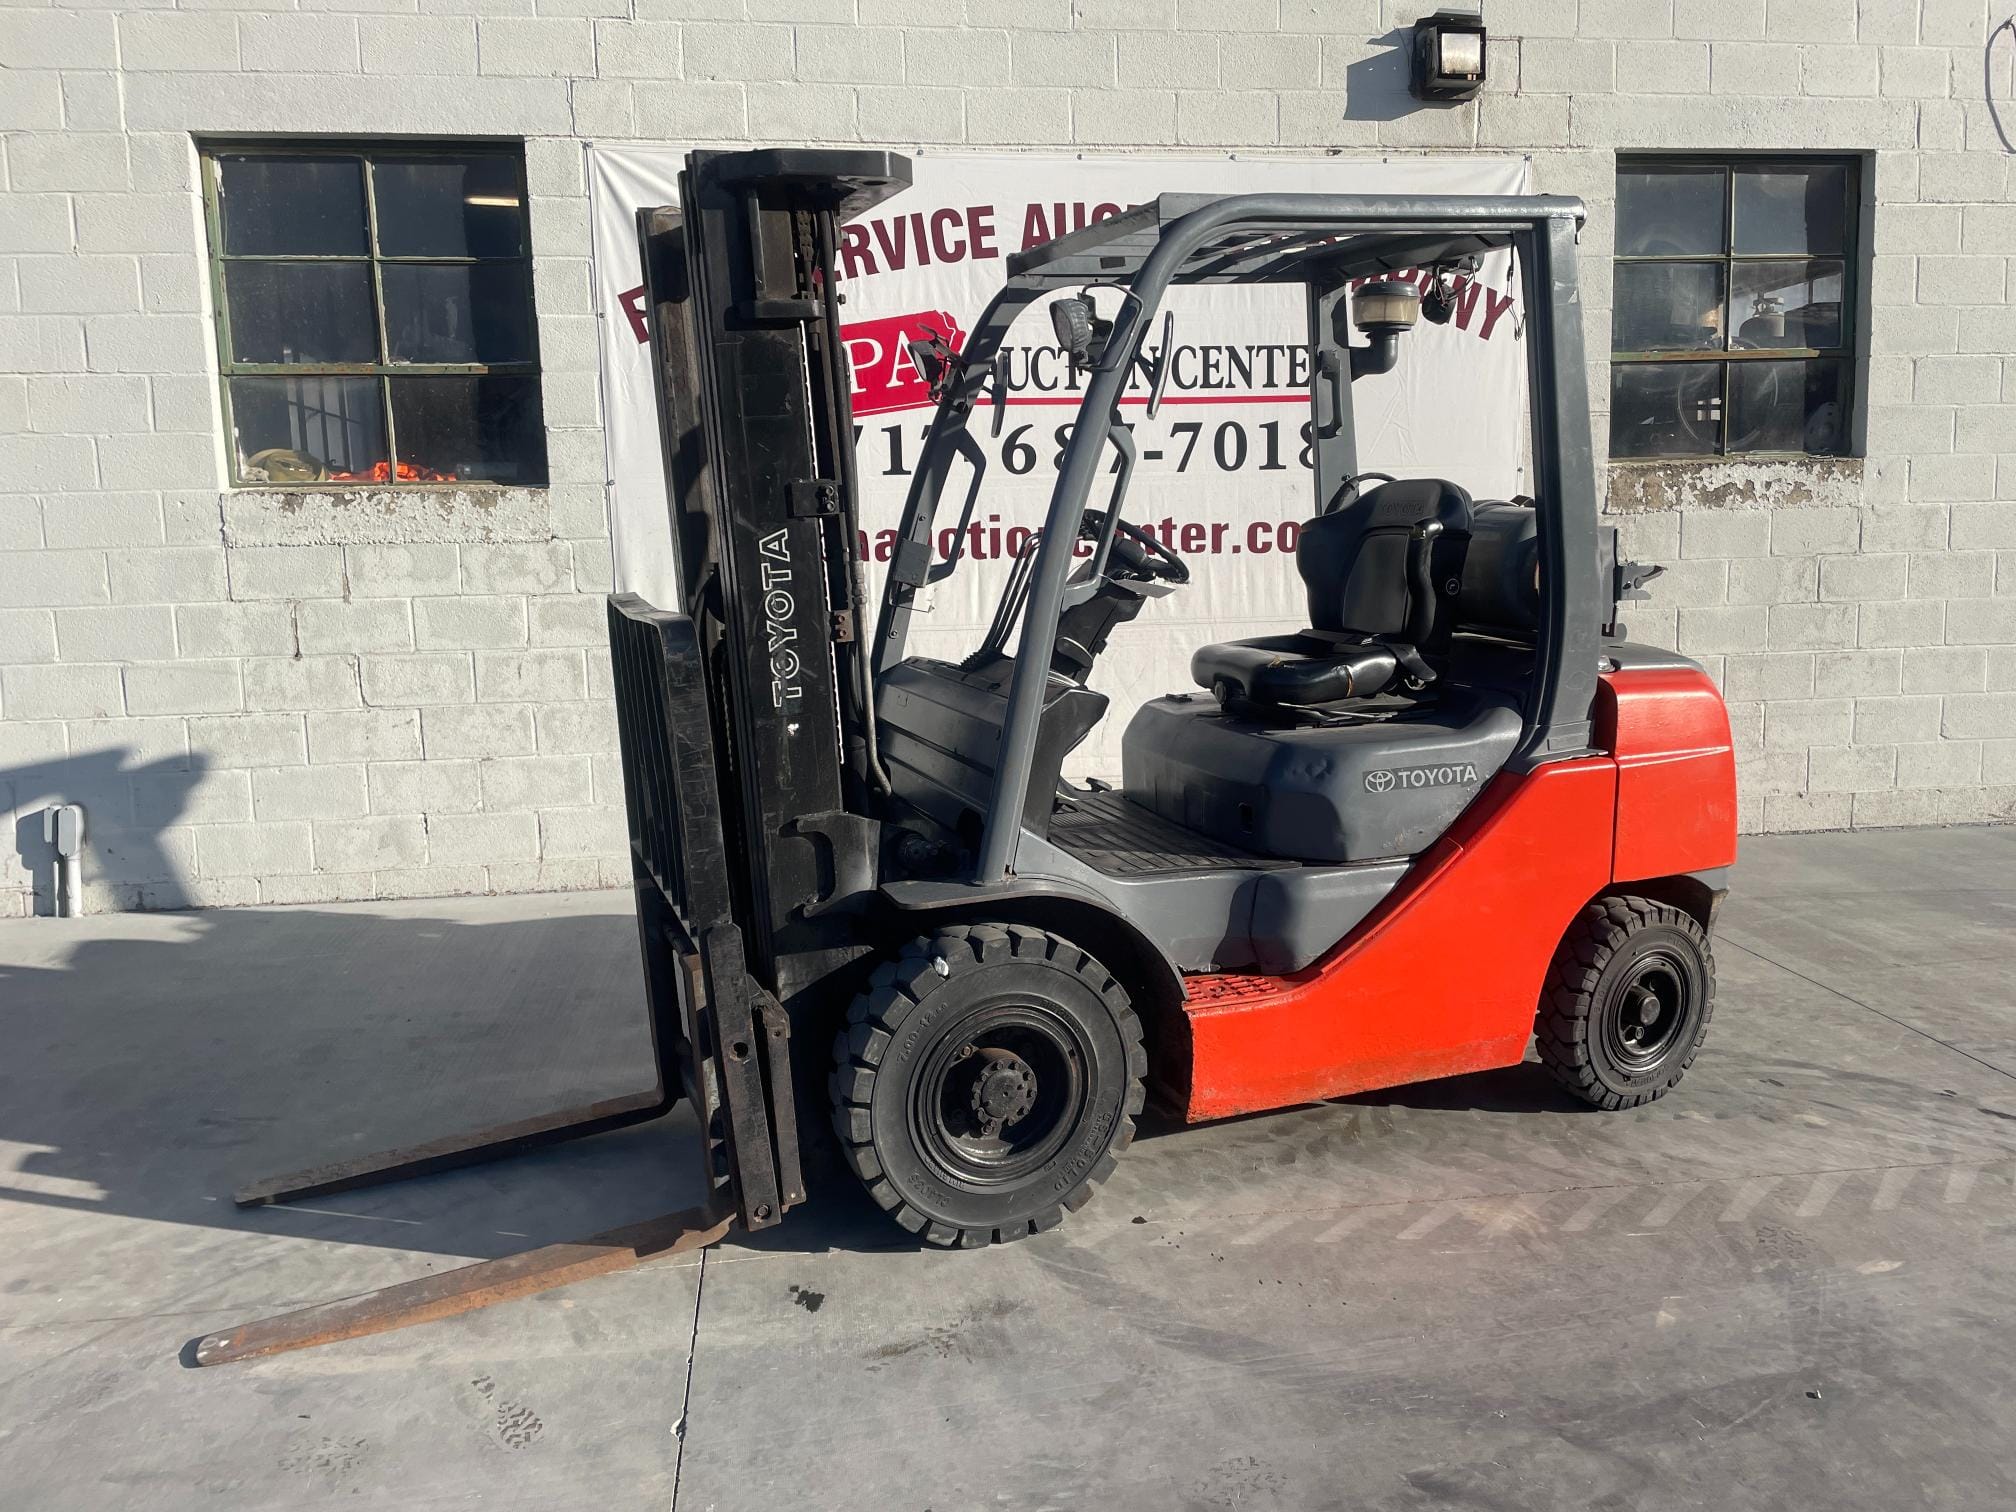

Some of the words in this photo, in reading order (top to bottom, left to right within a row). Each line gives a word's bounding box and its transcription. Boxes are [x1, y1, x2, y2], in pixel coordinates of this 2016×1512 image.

[812, 203, 1000, 284] RVICE
[1171, 345, 1310, 390] CENTE
[759, 528, 802, 708] TOYOTA
[1398, 765, 1478, 788] TOYOTA
